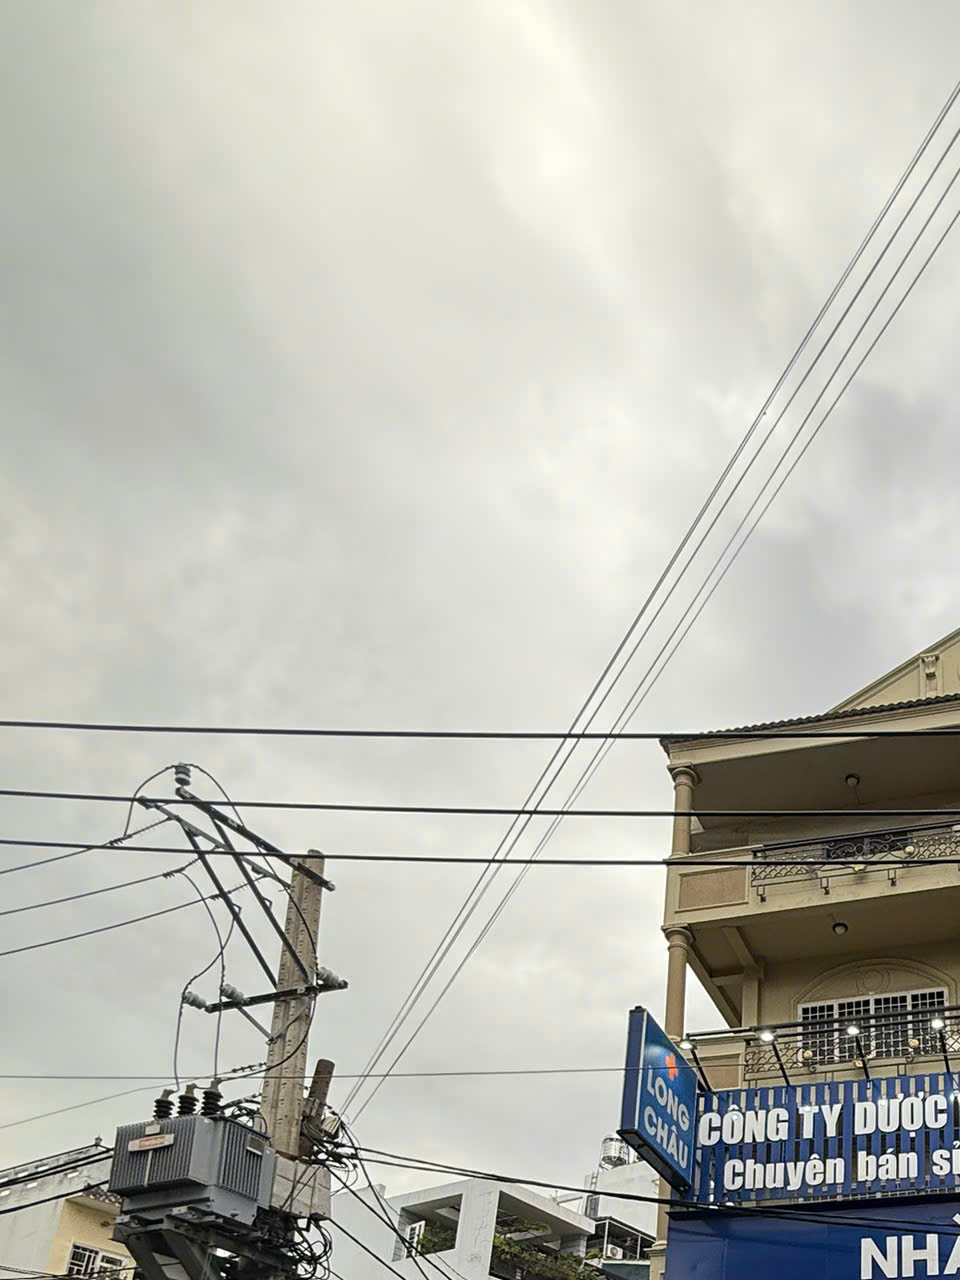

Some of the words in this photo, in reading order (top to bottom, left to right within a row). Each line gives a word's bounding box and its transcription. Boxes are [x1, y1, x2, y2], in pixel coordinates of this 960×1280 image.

[647, 1065, 690, 1131] LONG
[700, 1105, 789, 1146] CÔNG
[799, 1103, 843, 1139] TY
[854, 1091, 948, 1138] DƯỢC
[644, 1106, 689, 1168] CHÂU
[723, 1154, 845, 1191] Chuyên
[857, 1145, 918, 1182] bán
